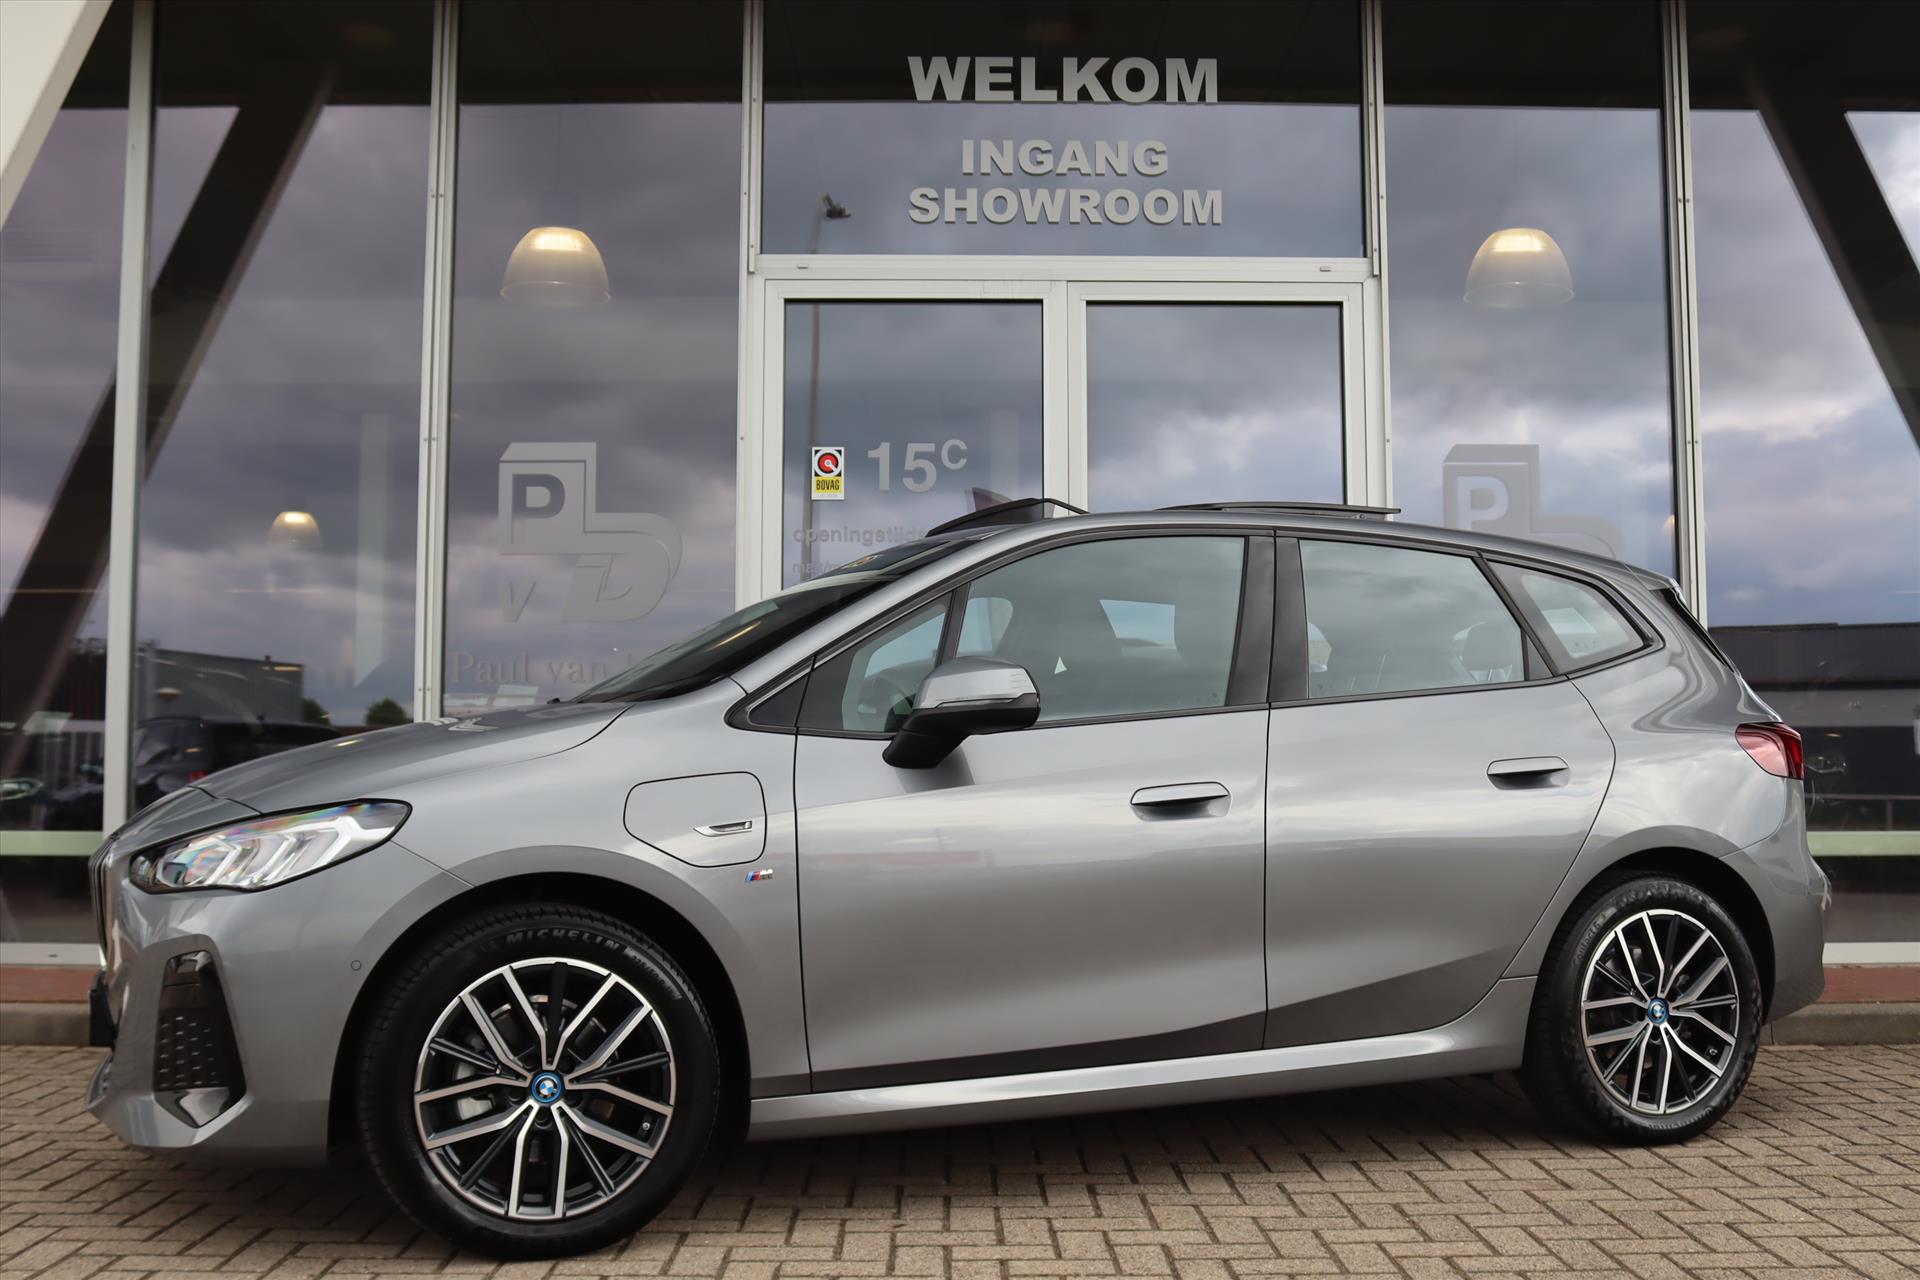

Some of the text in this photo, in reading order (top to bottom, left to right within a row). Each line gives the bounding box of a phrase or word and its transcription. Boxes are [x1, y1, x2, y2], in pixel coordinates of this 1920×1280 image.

[907, 55, 1219, 104] WELKOM
[961, 139, 1169, 177] INGANG
[907, 186, 1223, 225] SHOWROOM
[815, 479, 840, 492] BOVAG
[452, 650, 530, 684] Paul
[545, 655, 609, 684] van
[506, 928, 620, 952] MICHELIN
